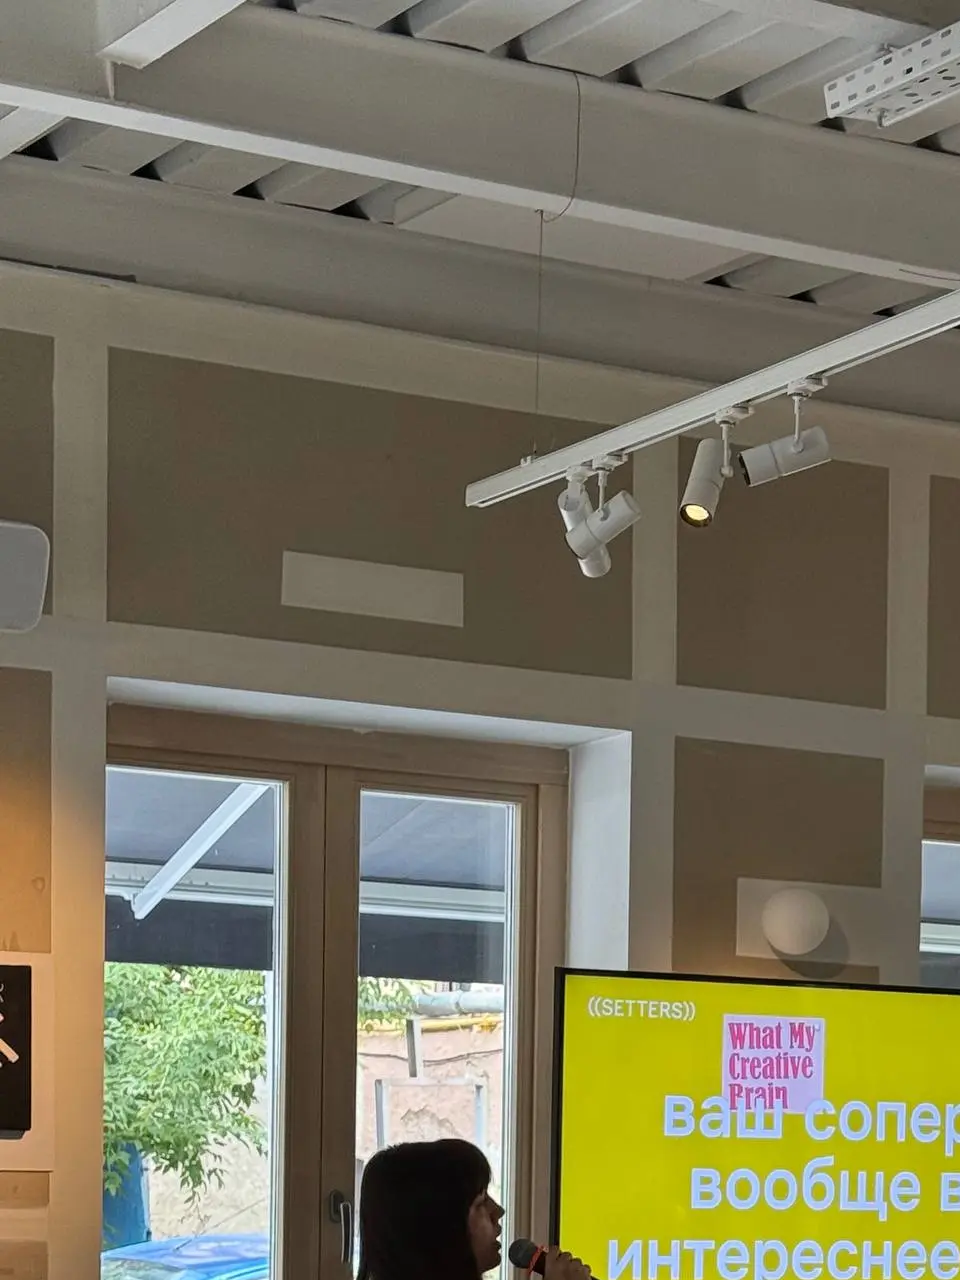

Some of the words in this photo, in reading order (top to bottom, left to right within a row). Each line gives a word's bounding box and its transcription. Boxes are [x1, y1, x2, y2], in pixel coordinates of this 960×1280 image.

[588, 996, 696, 1021] ((SETTERS))
[728, 1022, 783, 1050] What
[789, 1022, 816, 1052] My
[729, 1052, 814, 1080] Creative
[663, 1095, 784, 1139] ваш
[691, 1155, 921, 1221] вообще
